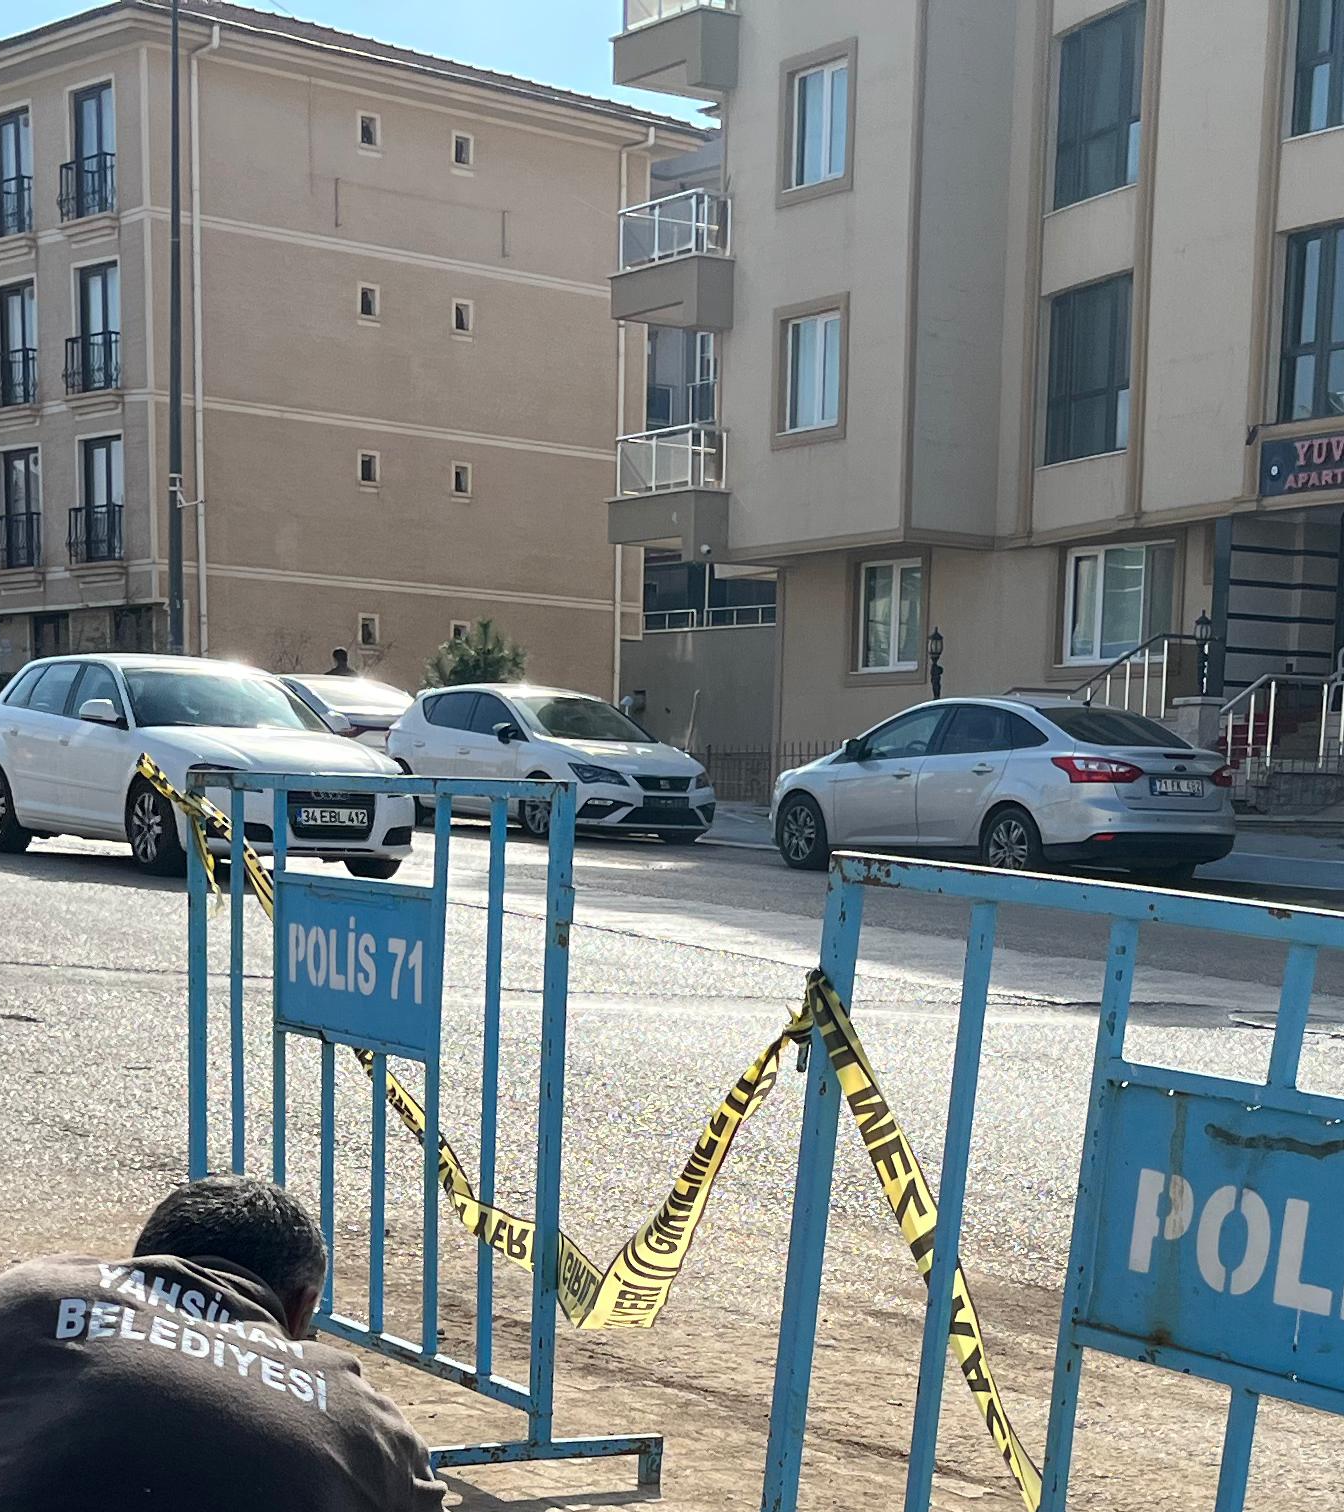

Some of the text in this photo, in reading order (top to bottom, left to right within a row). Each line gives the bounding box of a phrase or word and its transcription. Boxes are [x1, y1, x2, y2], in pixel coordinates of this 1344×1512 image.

[303, 810, 367, 824] 34 EBL 412
[288, 915, 423, 1005] POLİS 71
[55, 1298, 328, 1412] BELEDİYESİ
